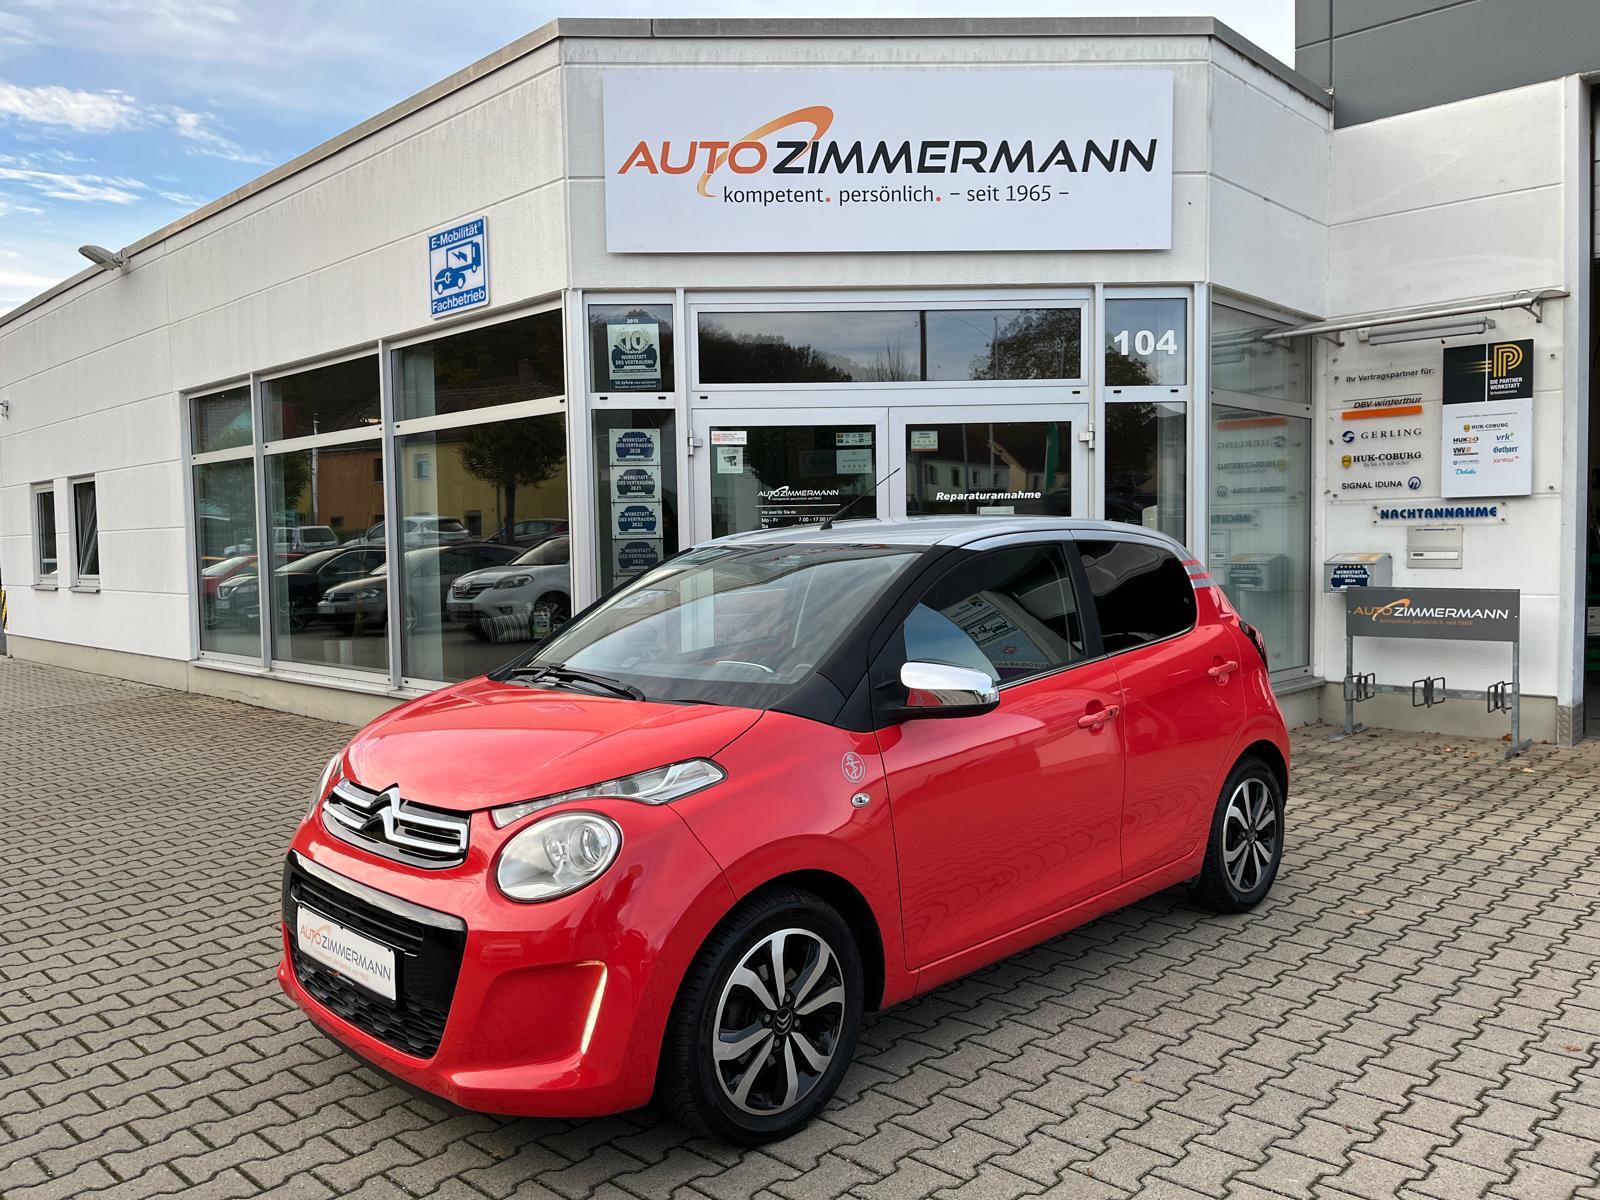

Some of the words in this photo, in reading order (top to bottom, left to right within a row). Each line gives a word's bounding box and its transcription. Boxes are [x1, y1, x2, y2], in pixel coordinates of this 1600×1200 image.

[617, 139, 768, 176] AUTO
[772, 138, 1158, 175] ZIMMERMANN
[723, 185, 831, 207] kompetent.
[839, 184, 942, 206] persönlich.
[966, 185, 1000, 202] seit
[1004, 184, 1052, 202] 1965
[432, 288, 486, 313] Fachbetrieb
[1113, 329, 1178, 356] 104
[1358, 370, 1418, 381] Vertragspartner
[1360, 427, 1422, 440] GERLING
[1496, 432, 1511, 441] vrk
[1353, 451, 1422, 463] HUK-COBURG
[1341, 481, 1374, 490] SIGNAL
[1375, 480, 1403, 488] IDUNA
[780, 489, 839, 497] ZIMMERMANN
[936, 491, 1042, 503] Reparaturannahme
[1380, 506, 1498, 520] NACHTANNAHME
[1353, 606, 1393, 616] AUTO
[1393, 606, 1509, 619] ZIMMERMANN
[300, 923, 321, 946] AUTO
[321, 935, 391, 981] ZIMMERMANN
